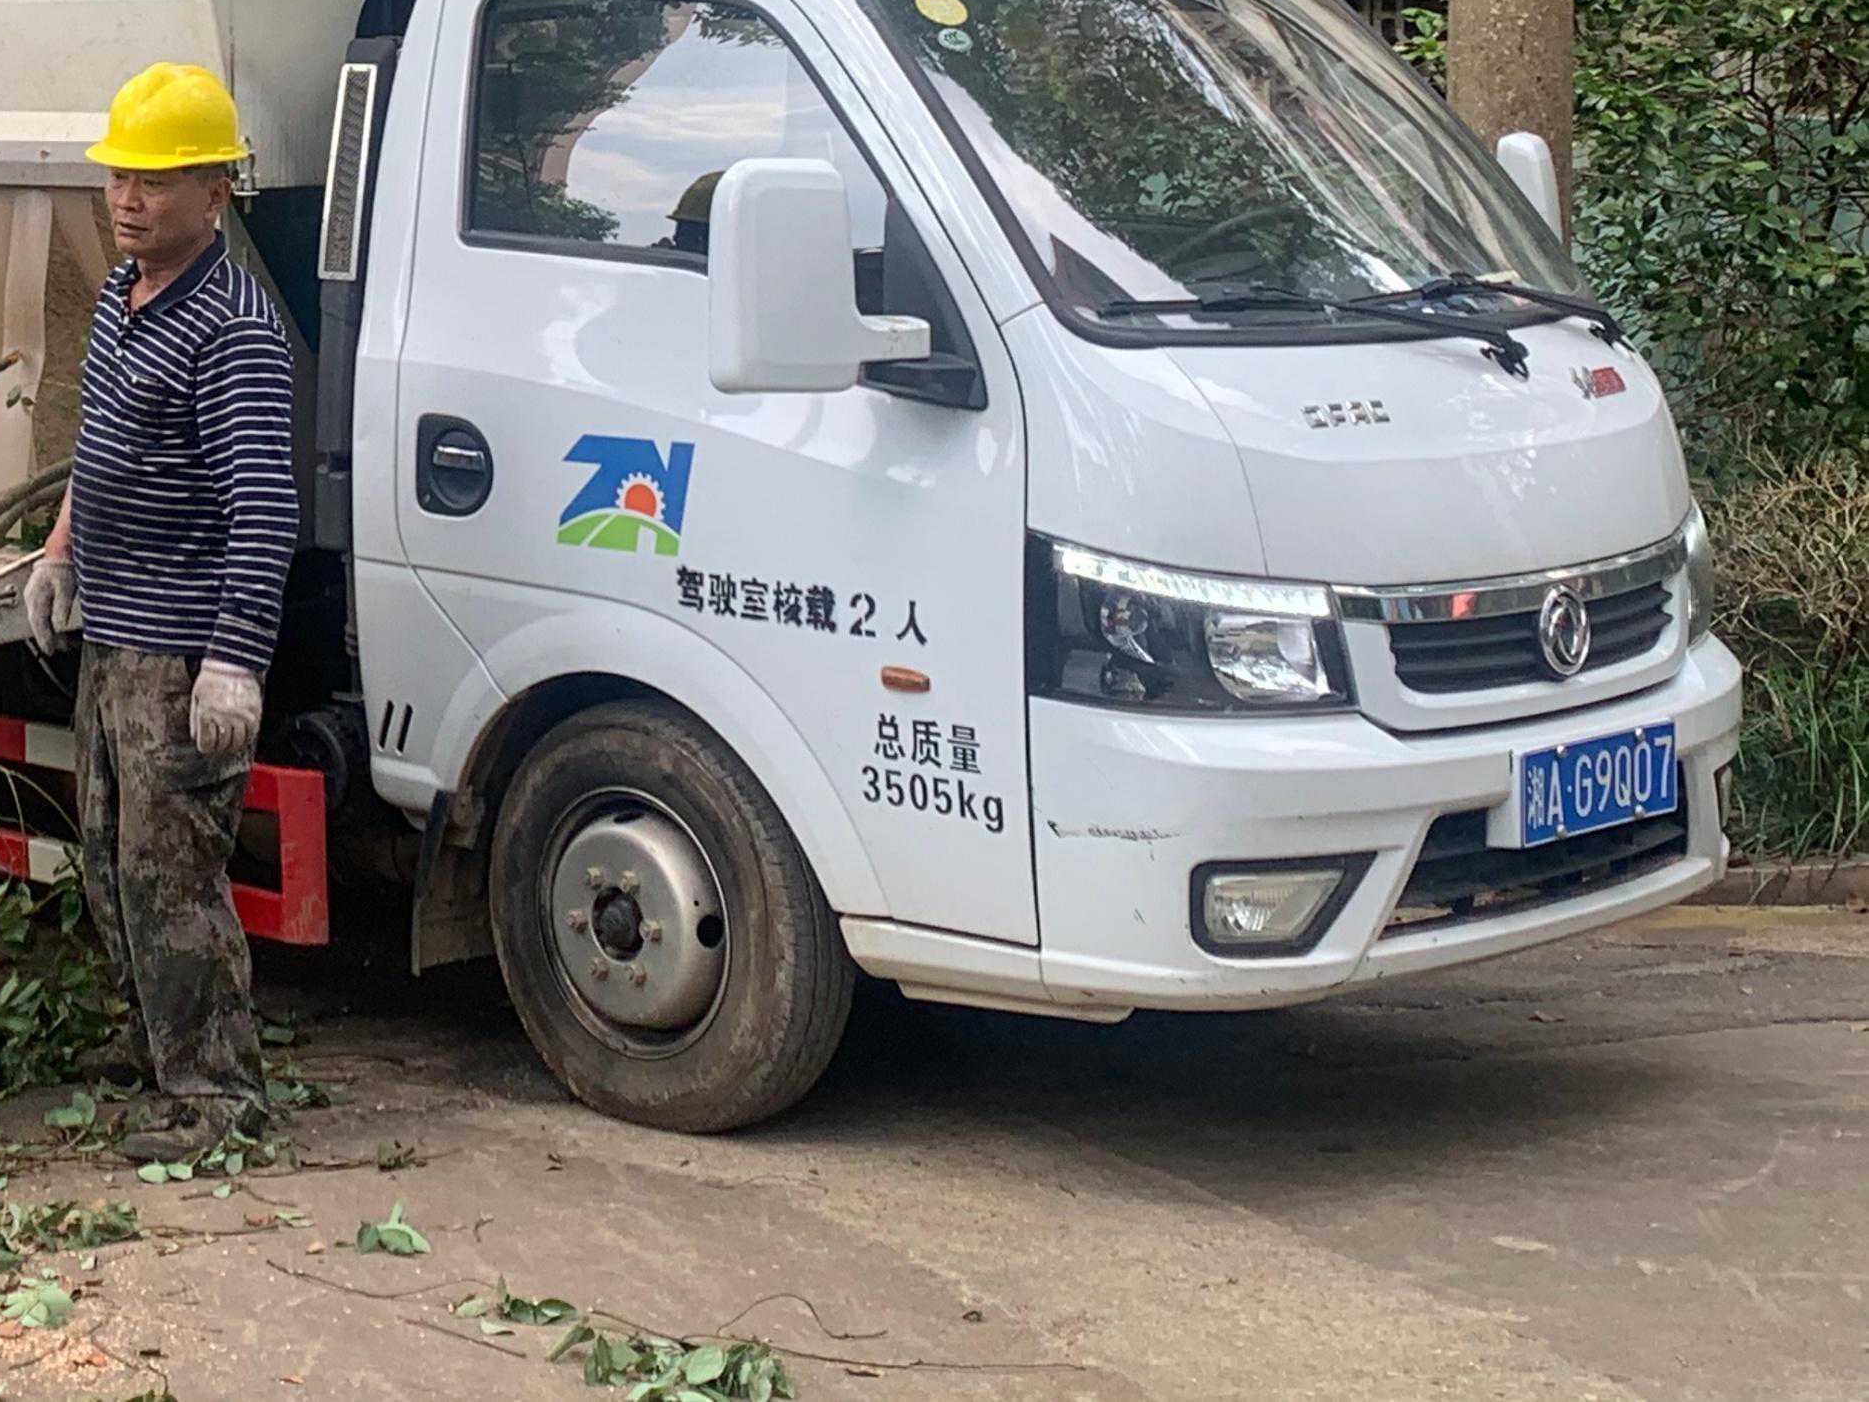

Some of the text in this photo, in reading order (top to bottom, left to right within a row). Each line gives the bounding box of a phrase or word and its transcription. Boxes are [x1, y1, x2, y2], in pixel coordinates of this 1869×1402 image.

[676, 565, 928, 646] 驾驶室核载 2 人
[873, 713, 983, 774] 总质量
[860, 765, 1005, 834] 3505kg
